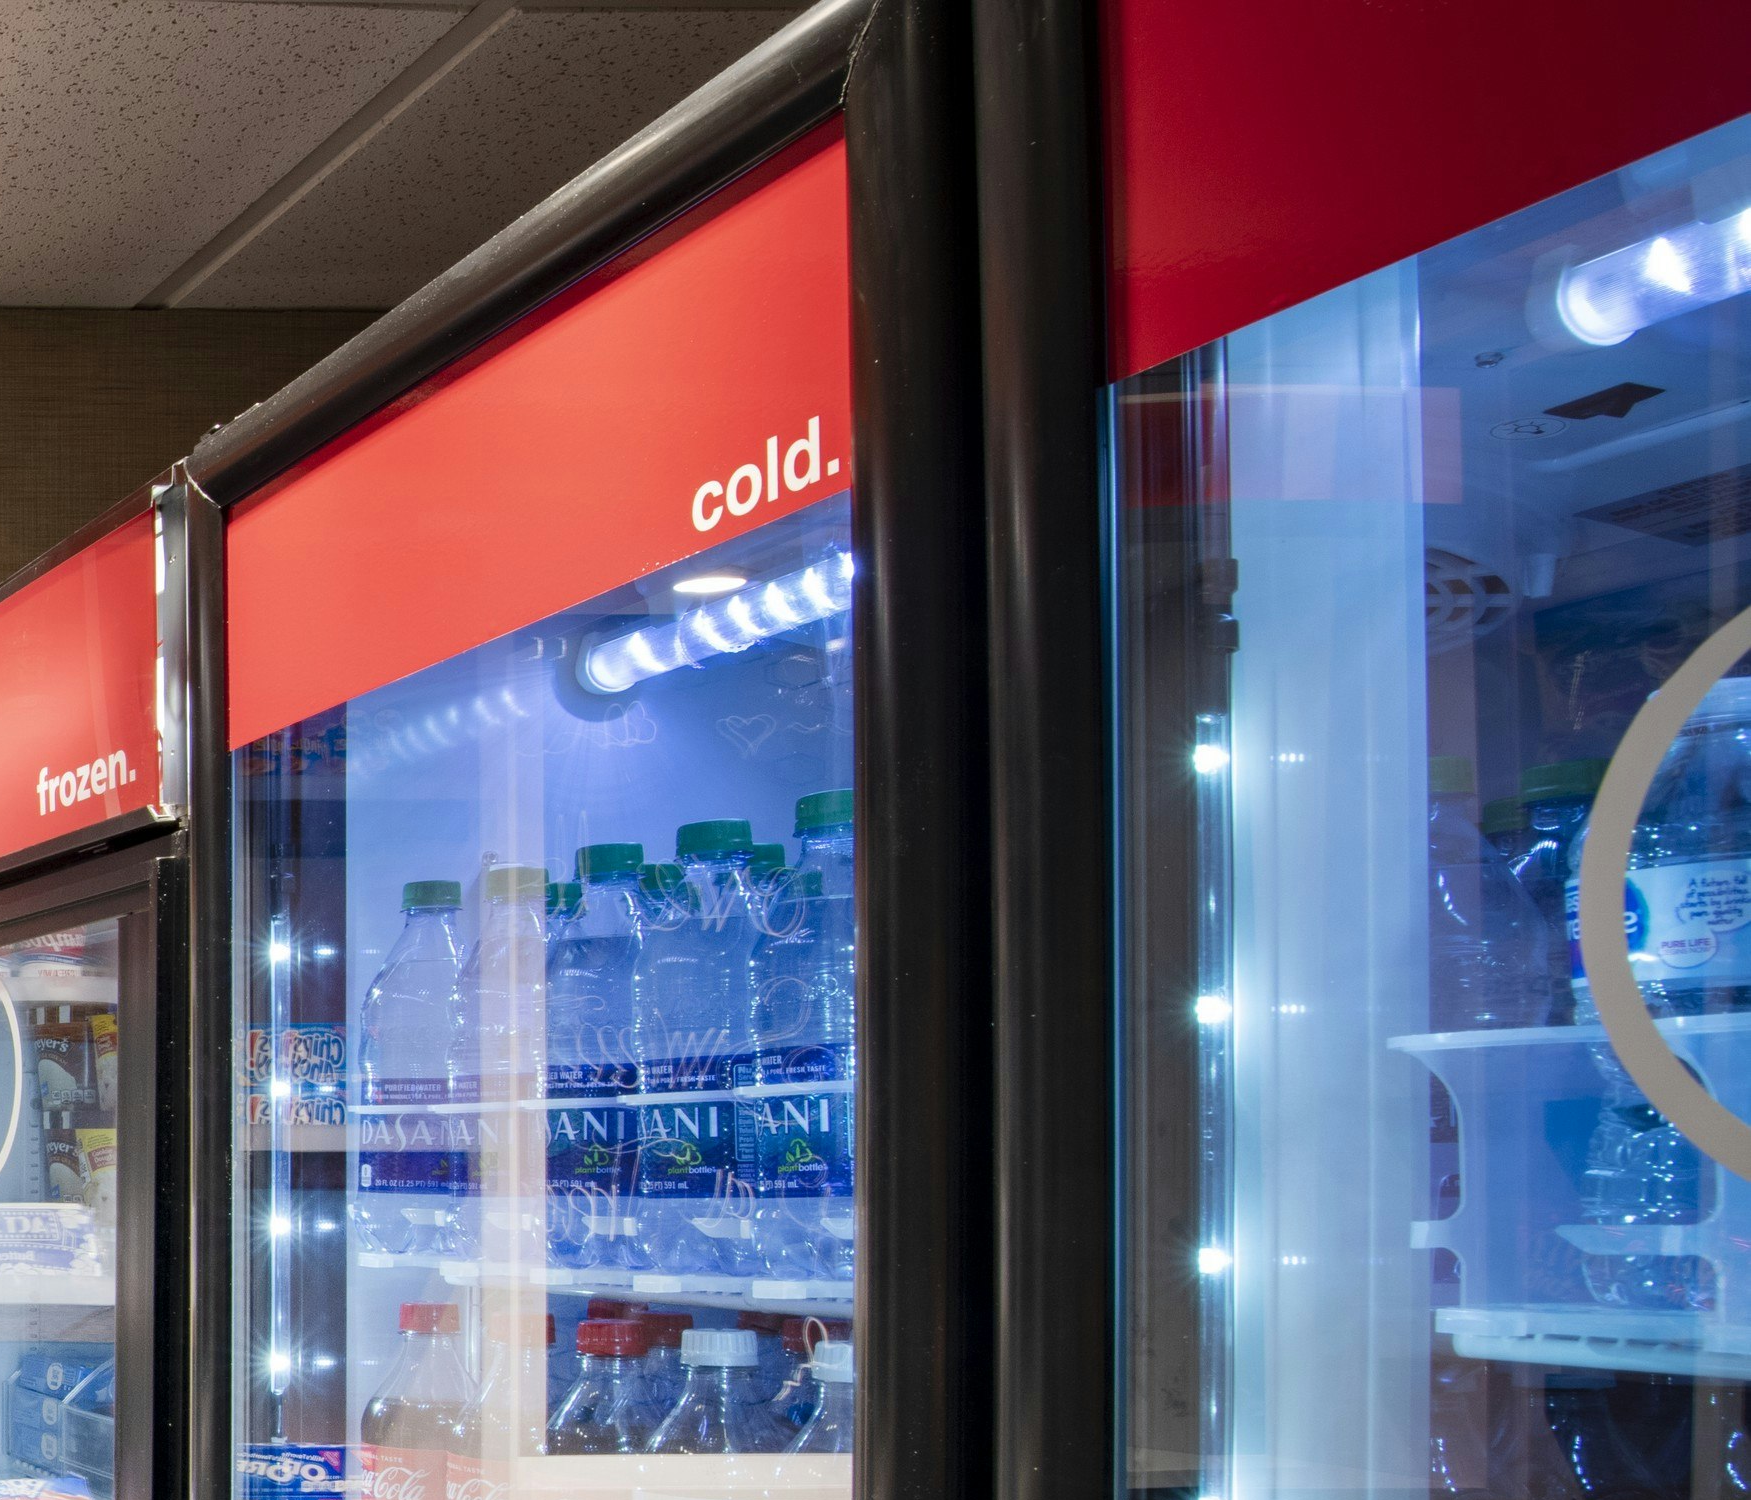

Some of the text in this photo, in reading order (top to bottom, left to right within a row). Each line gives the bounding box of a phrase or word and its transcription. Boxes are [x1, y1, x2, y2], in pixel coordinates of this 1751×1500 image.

[692, 416, 839, 532] cold.
[36, 744, 136, 817] frozen.
[1662, 938, 1710, 948] PURE LIFE
